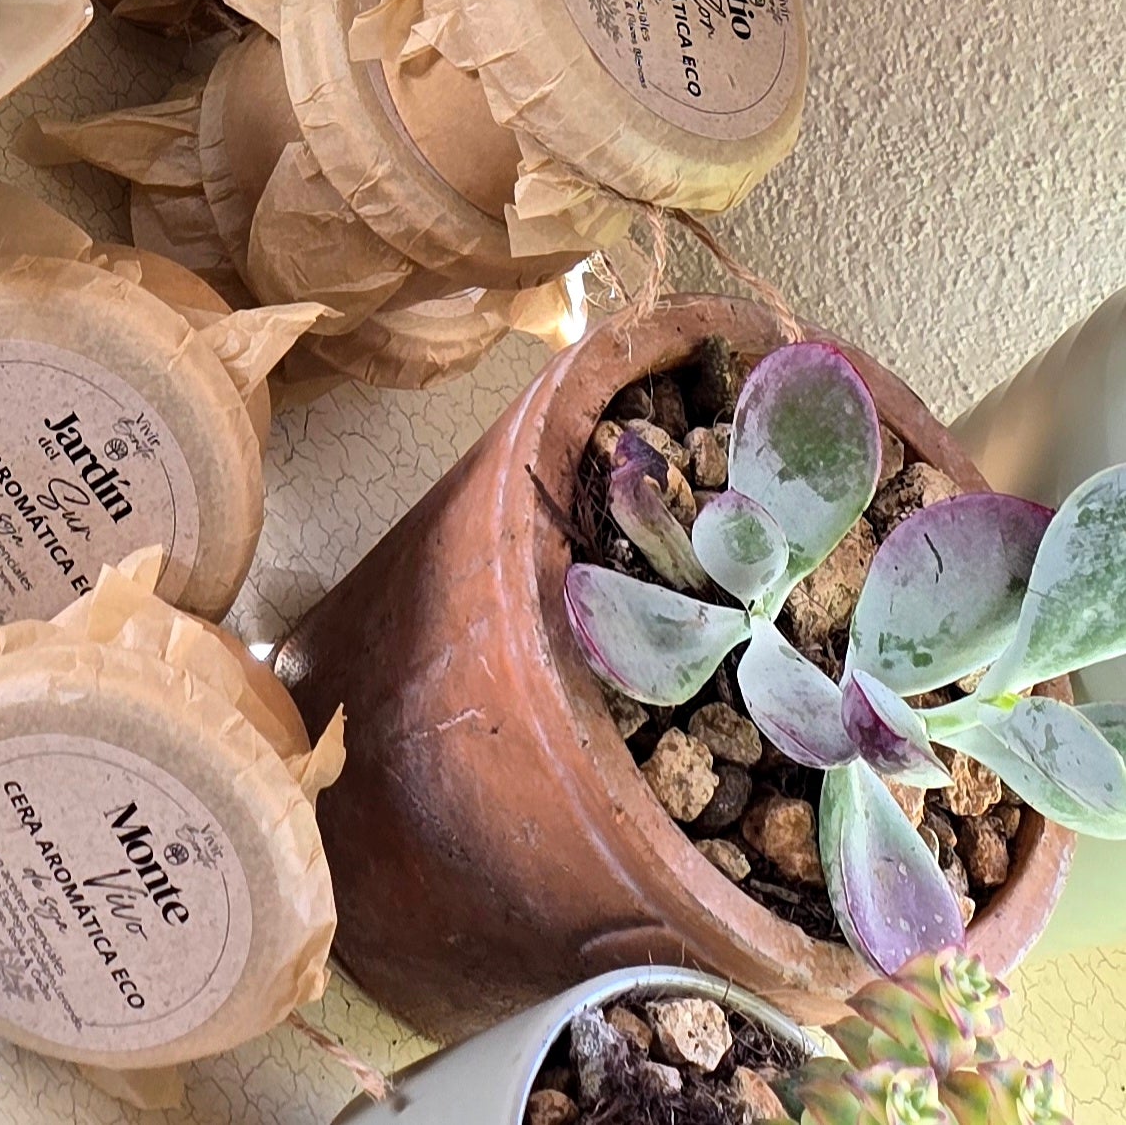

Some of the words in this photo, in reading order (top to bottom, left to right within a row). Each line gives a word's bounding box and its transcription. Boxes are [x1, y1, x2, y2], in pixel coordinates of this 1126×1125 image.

[682, 54, 702, 98] ECO
[38, 436, 61, 461] del
[130, 411, 161, 452] Vivir
[43, 410, 133, 525] Jardín
[36, 477, 91, 542] Sur
[3, 781, 43, 837] CERA
[35, 840, 118, 966] AROMÁTICA
[110, 967, 145, 1009] ECO
[20, 866, 53, 894] de
[103, 801, 190, 926] Monte
[0, 869, 30, 913] aceites
[26, 913, 67, 977] esenciales
[82, 868, 149, 942] Vivo
